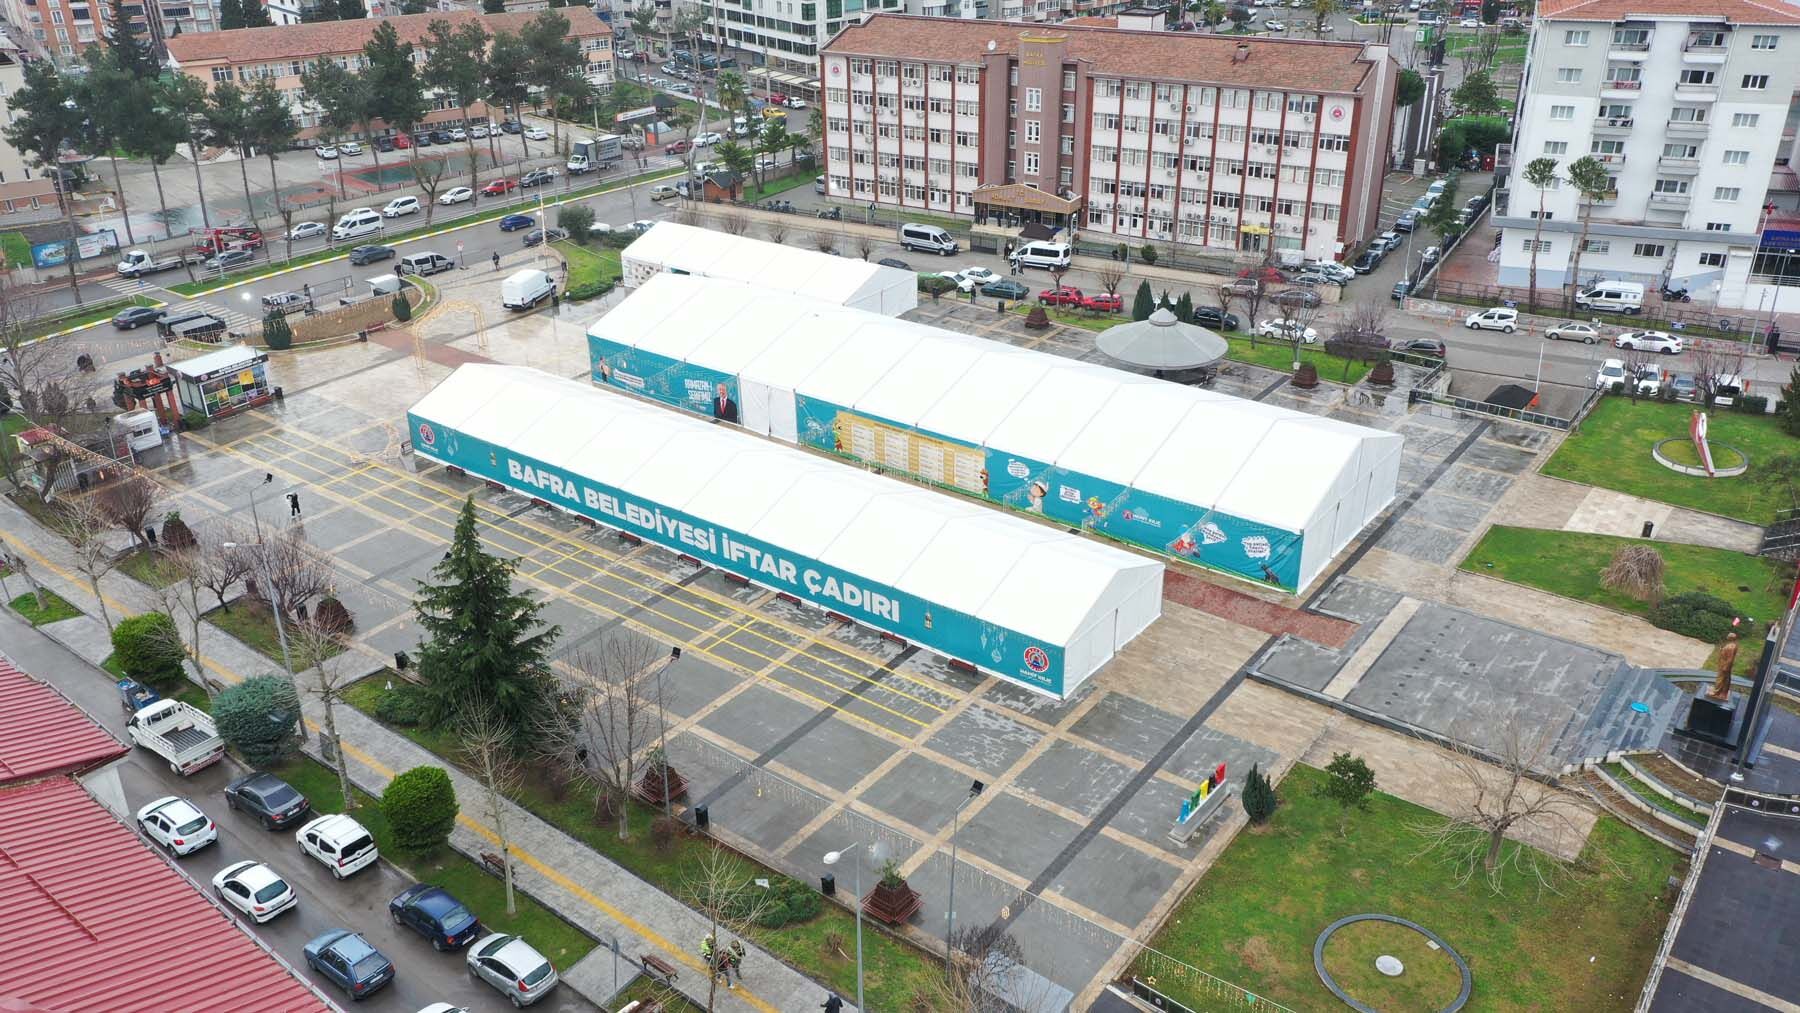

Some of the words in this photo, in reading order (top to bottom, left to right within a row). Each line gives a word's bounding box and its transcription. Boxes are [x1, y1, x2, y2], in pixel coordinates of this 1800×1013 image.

[507, 458, 581, 504] BAFRA
[584, 486, 717, 555] BELEDİYESİ
[722, 532, 798, 585] İFTAR
[803, 569, 900, 623] ÇADIRI
